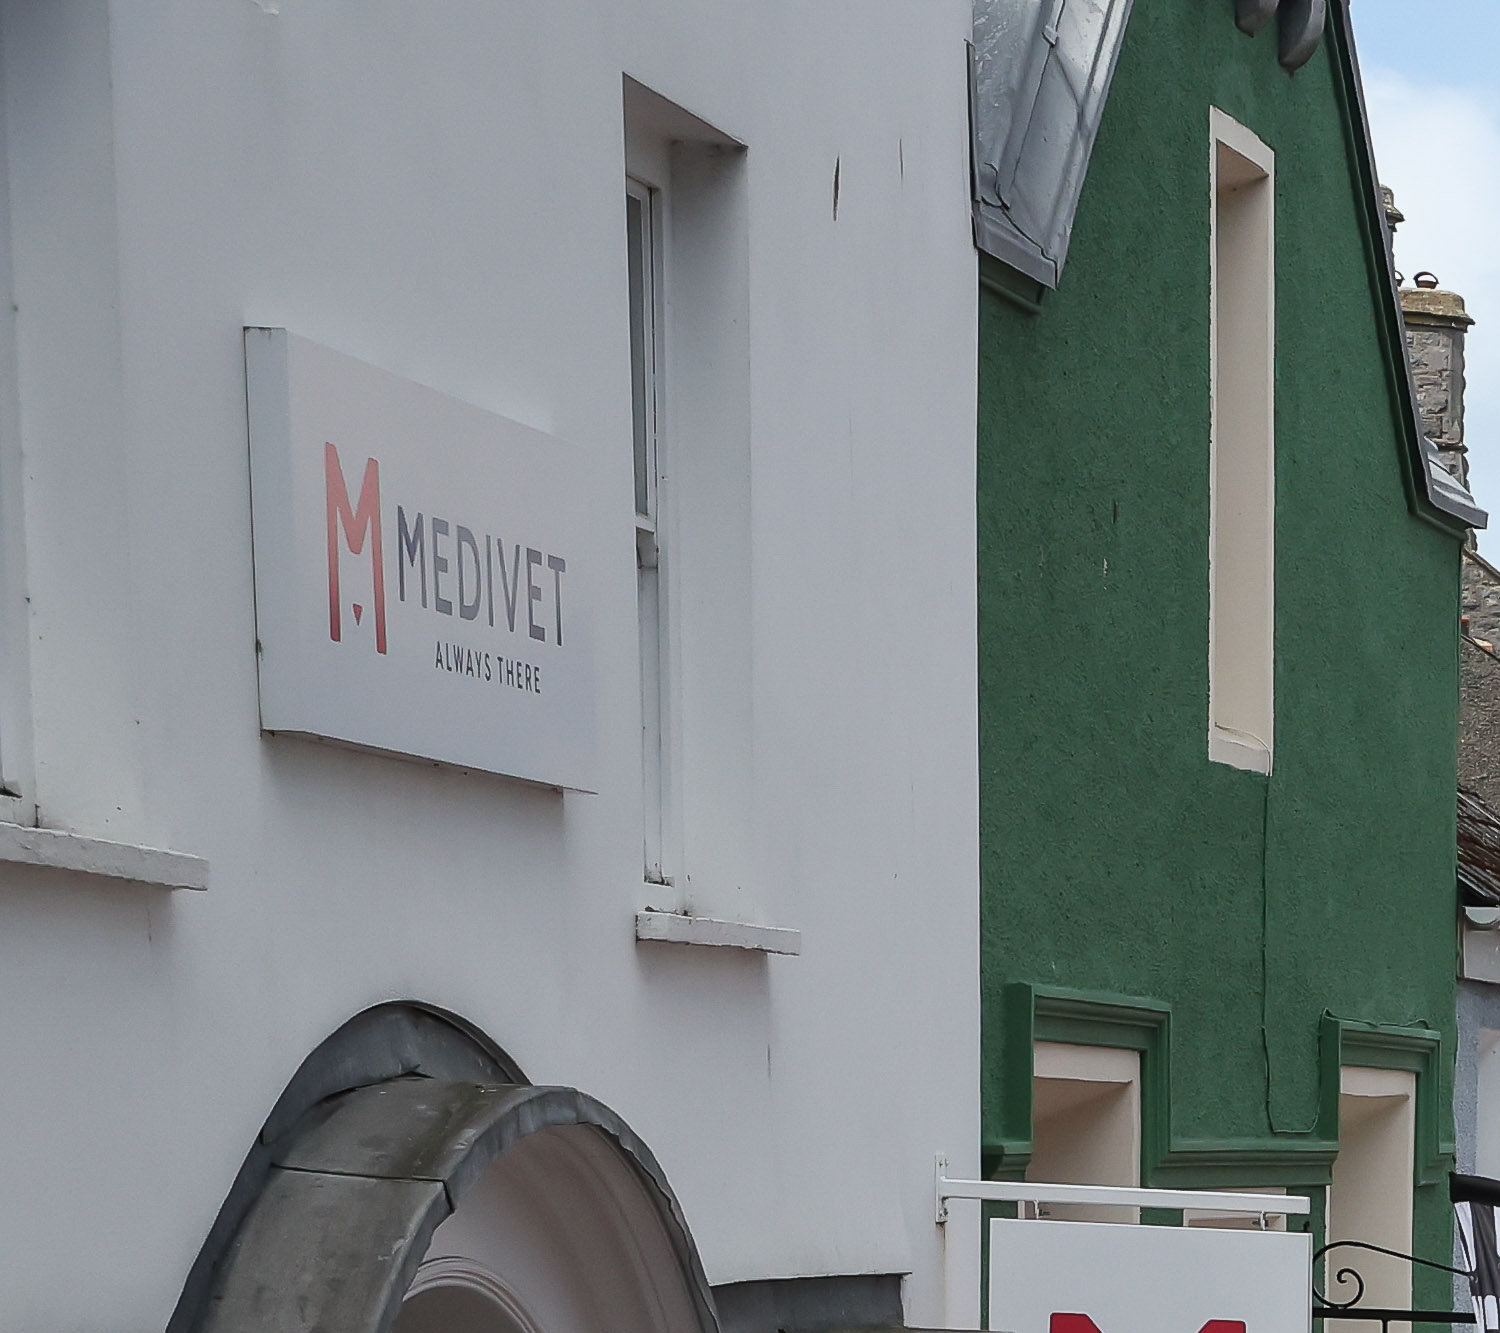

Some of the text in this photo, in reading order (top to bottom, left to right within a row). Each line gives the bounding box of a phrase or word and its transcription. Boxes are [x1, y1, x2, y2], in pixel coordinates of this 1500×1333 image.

[398, 504, 567, 647] MEDIVET
[436, 641, 542, 693] ALWAYS THERE
